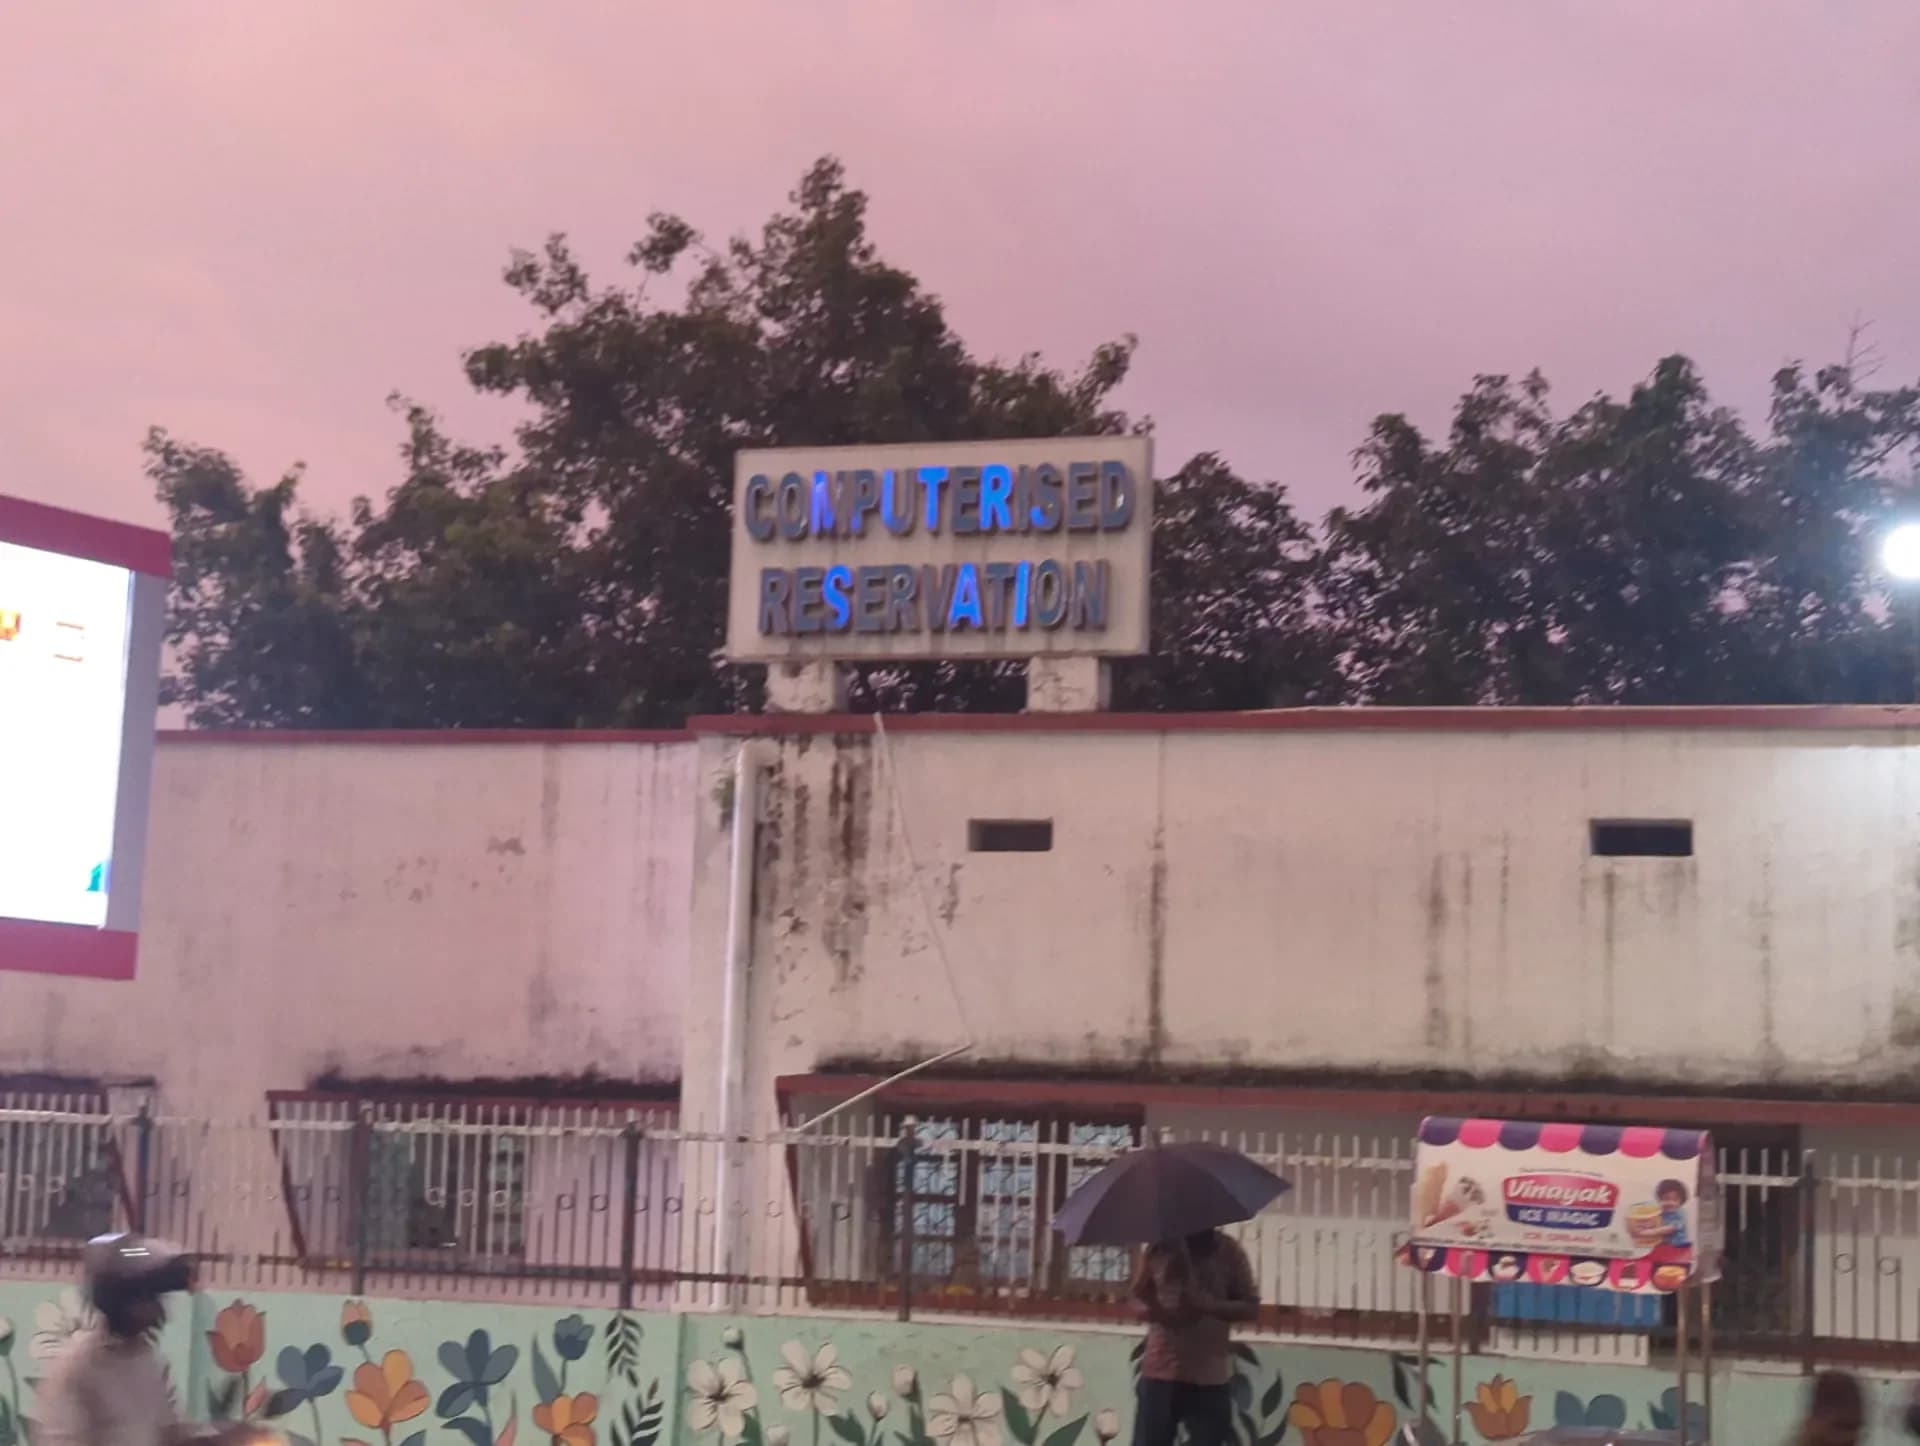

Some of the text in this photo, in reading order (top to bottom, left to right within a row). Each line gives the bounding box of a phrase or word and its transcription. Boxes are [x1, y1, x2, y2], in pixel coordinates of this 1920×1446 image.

[745, 460, 1136, 541] COMPUTERISED
[758, 558, 1109, 634] RESERVATION
[1508, 1179, 1612, 1205] Vinayak
[1518, 1209, 1599, 1226] ICE MAGIC
